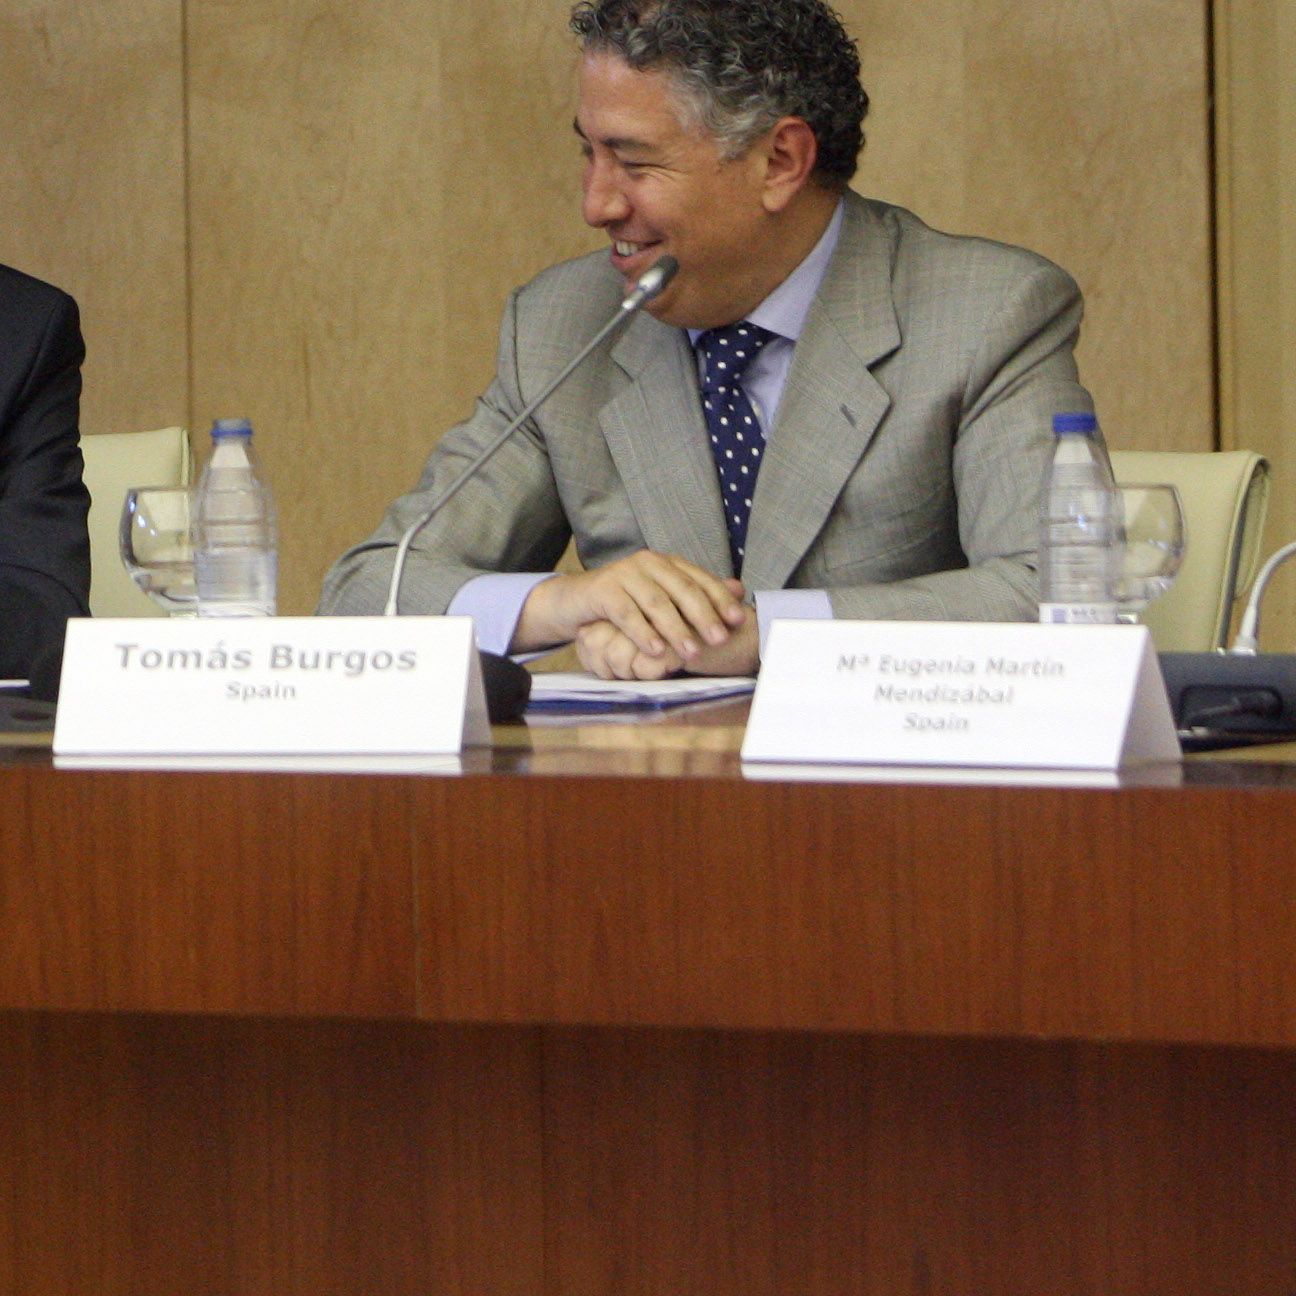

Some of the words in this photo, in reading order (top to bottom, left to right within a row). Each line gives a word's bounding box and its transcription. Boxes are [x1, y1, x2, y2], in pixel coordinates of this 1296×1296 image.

[114, 640, 253, 670] Tomás
[269, 643, 417, 677] Burgos
[878, 655, 976, 677] Eugenia
[226, 680, 297, 701] Spain
[903, 712, 970, 732] Spain
